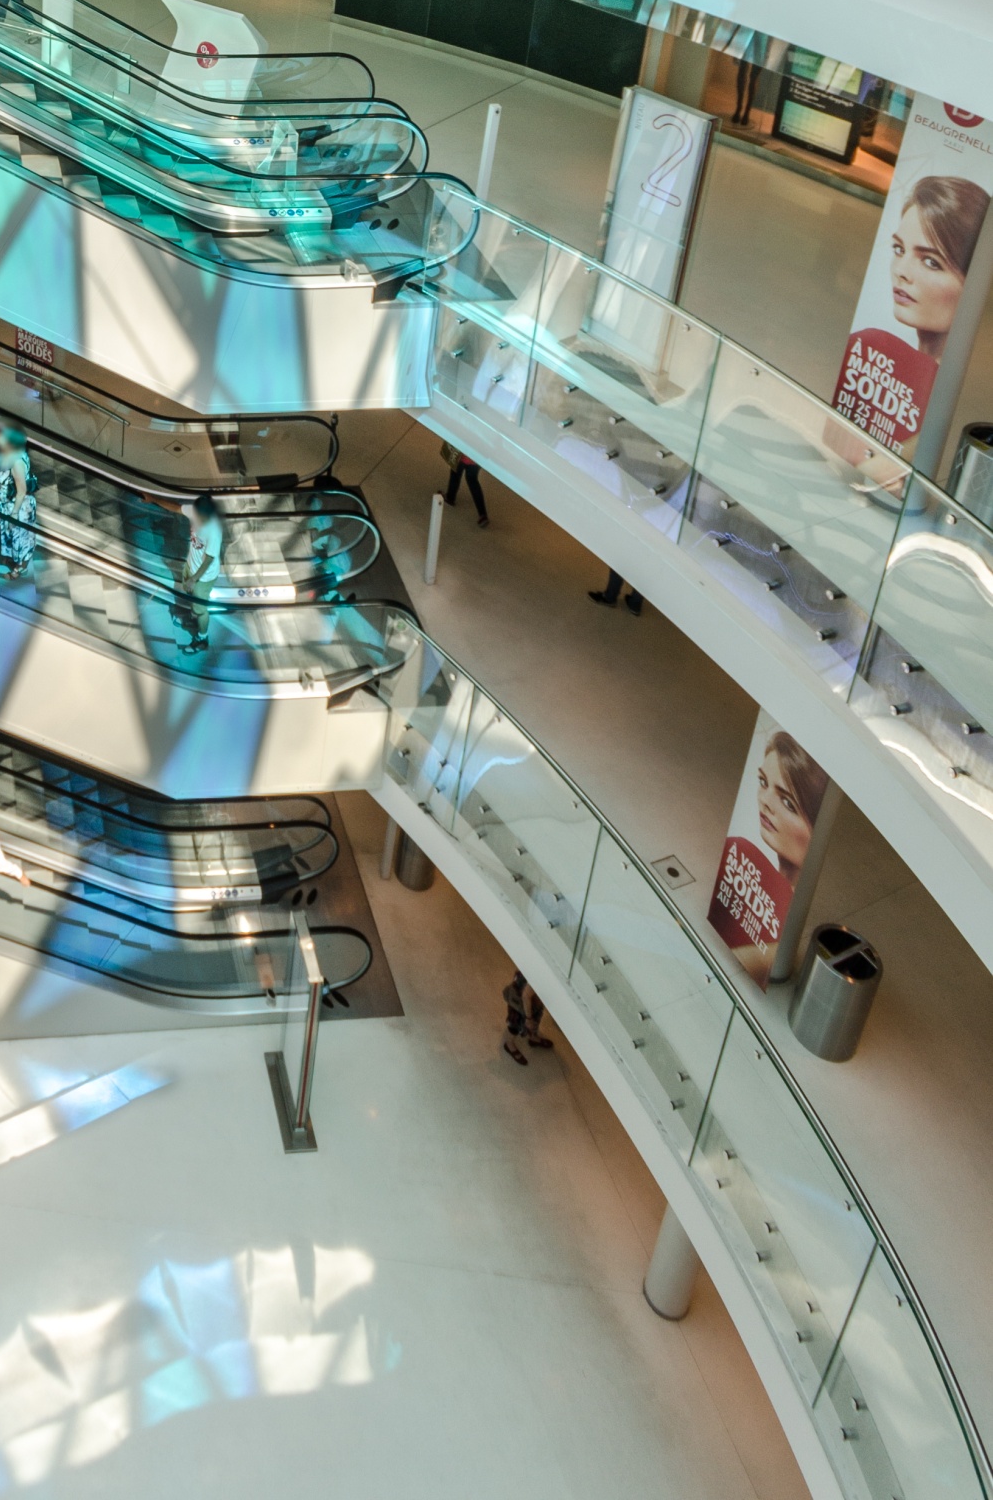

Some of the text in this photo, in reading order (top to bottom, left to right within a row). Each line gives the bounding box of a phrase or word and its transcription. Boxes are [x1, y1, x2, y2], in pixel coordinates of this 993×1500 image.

[634, 102, 646, 130] NIVEAU
[641, 113, 693, 207] 2
[18, 339, 53, 363] SOLDES
[850, 337, 895, 374] À VOS
[837, 390, 896, 436] DU 25 JUIN
[843, 368, 920, 432] SOLDES
[741, 852, 762, 883] VOS
[716, 891, 768, 955] AU 29 JUILLET
[719, 880, 763, 934] DU 25 JUIN
[723, 865, 780, 939] SOLDES
